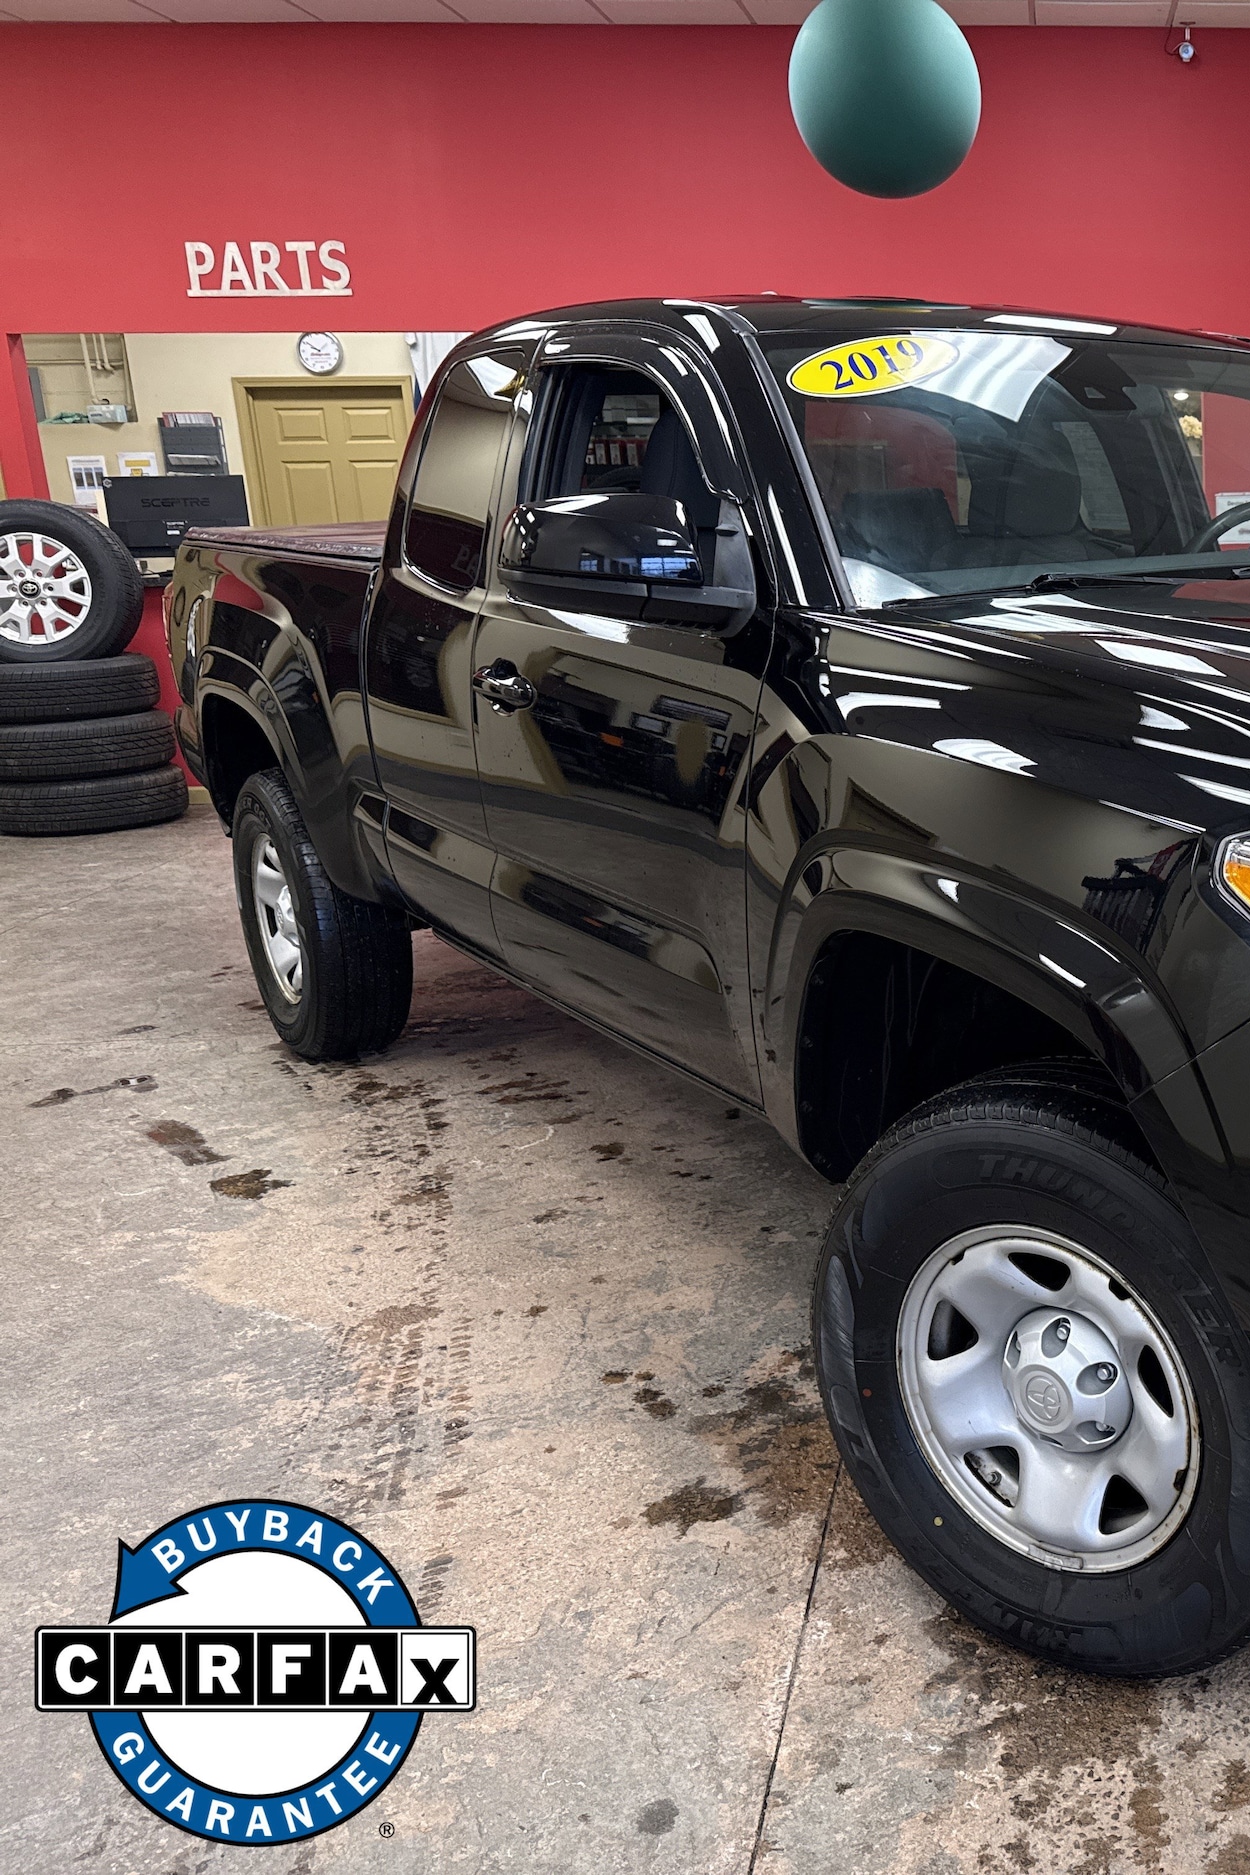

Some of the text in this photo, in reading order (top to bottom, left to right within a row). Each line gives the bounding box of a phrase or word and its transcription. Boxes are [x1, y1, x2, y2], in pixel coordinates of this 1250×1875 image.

[184, 240, 353, 293] PARTS
[820, 339, 924, 390] 2019
[140, 497, 210, 508] SCEPTRE
